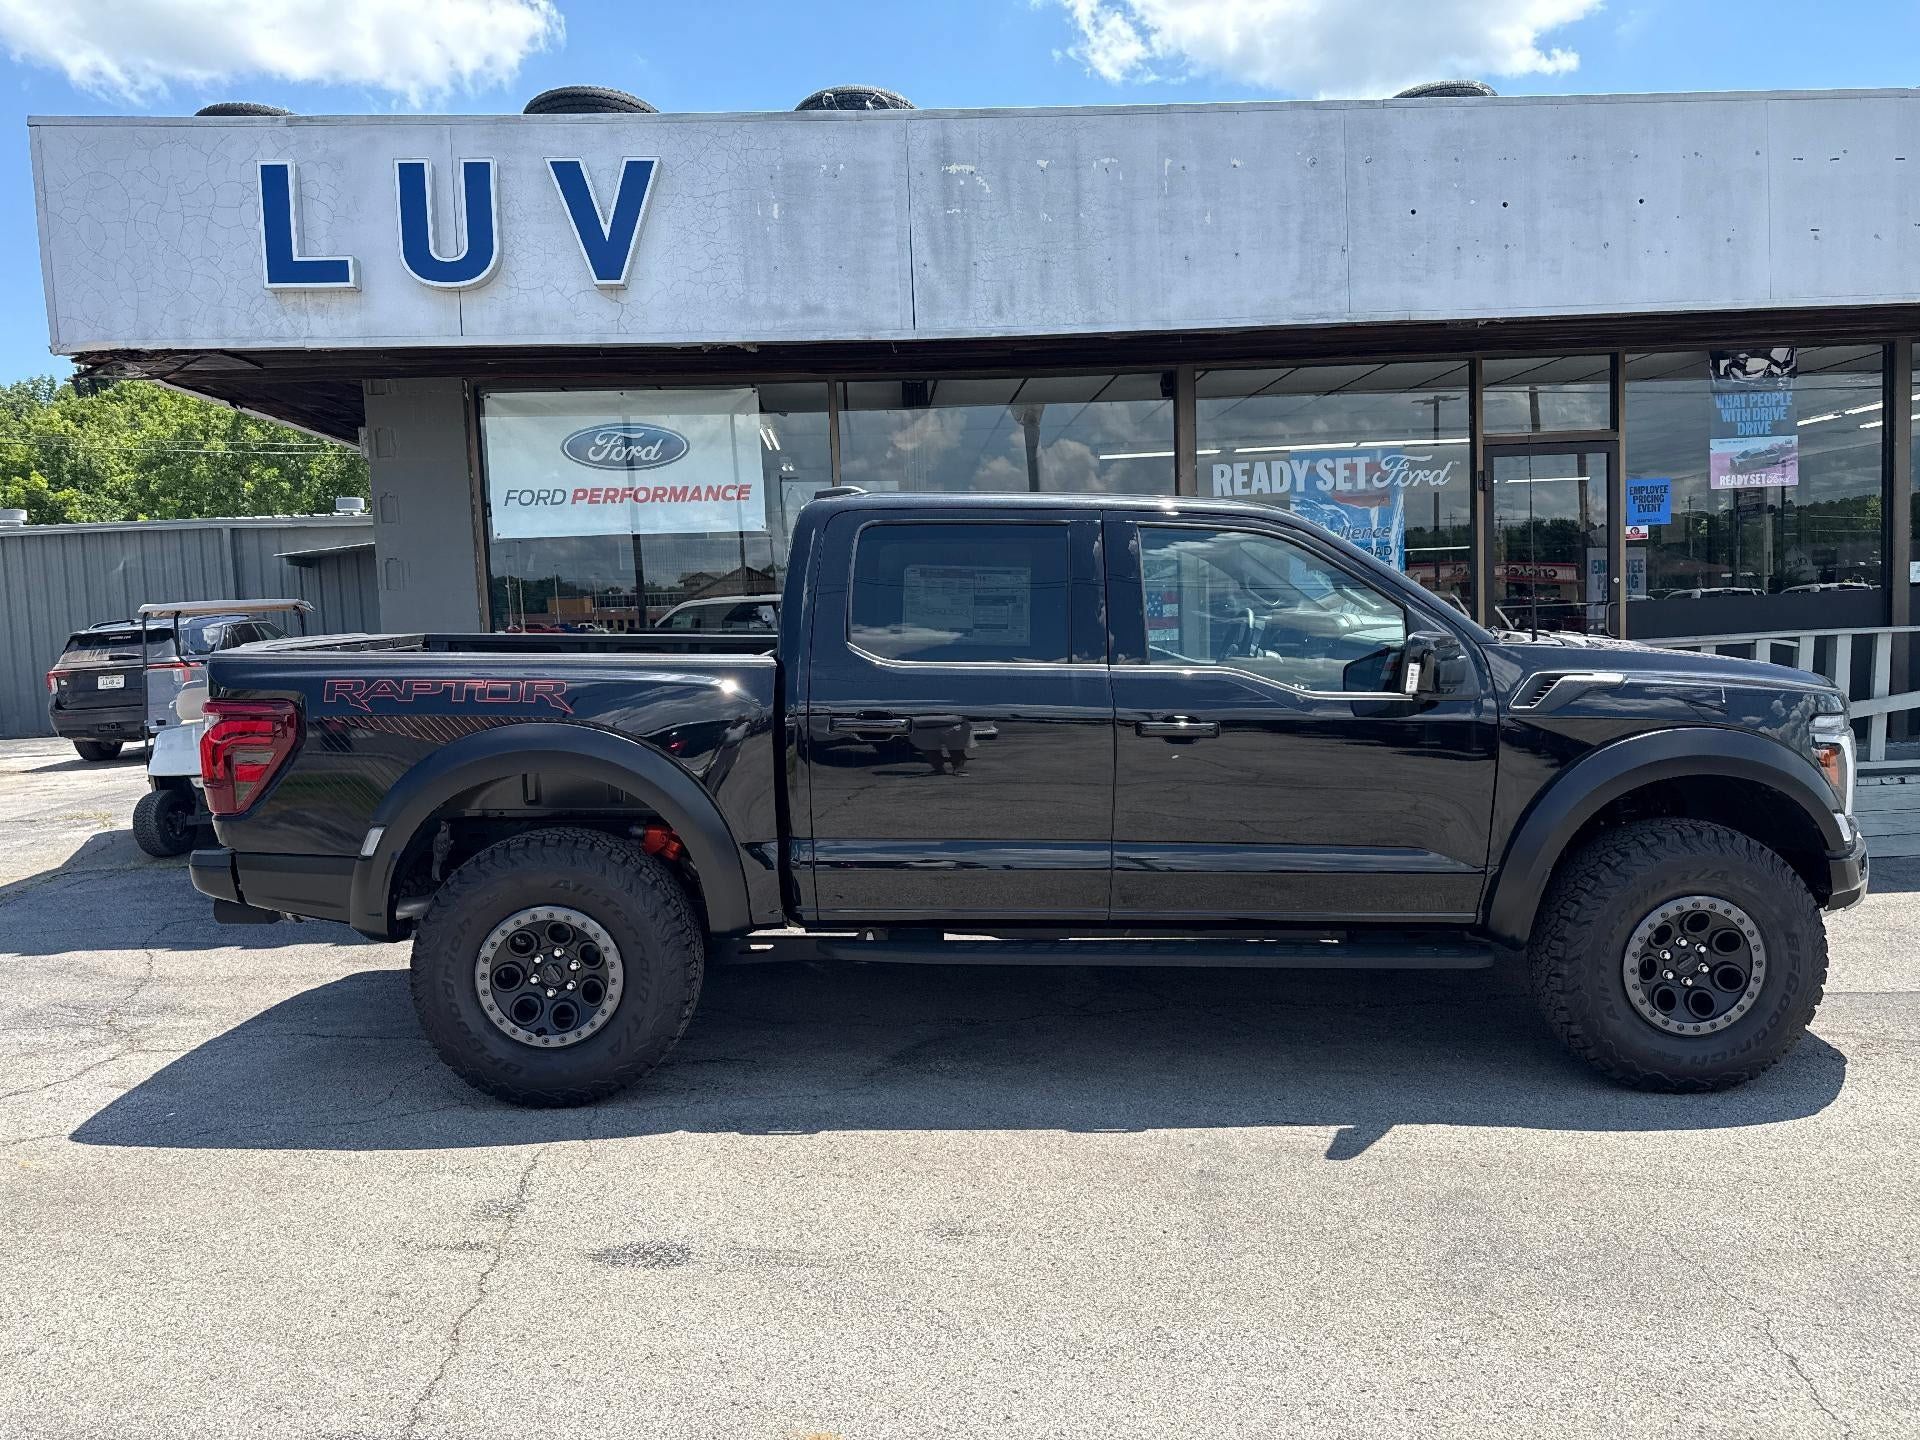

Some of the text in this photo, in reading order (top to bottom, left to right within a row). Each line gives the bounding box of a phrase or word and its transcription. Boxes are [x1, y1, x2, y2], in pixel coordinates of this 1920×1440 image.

[256, 156, 661, 291] LUV
[1715, 391, 1792, 408] WHAT PEOPLE
[1721, 406, 1787, 422] WITH DRIVE
[1737, 421, 1772, 435] DRIVE
[587, 431, 662, 462] Ford
[1212, 454, 1453, 497] READY SET Ford
[1720, 474, 1749, 486] READY
[1750, 473, 1766, 485] SET
[504, 484, 752, 506] FORD PERFORMANCE
[1630, 485, 1668, 495] EMPLOYEE
[1633, 494, 1665, 504] PRICING
[1638, 504, 1661, 513] EVENT
[323, 679, 574, 714] RAPTOR
